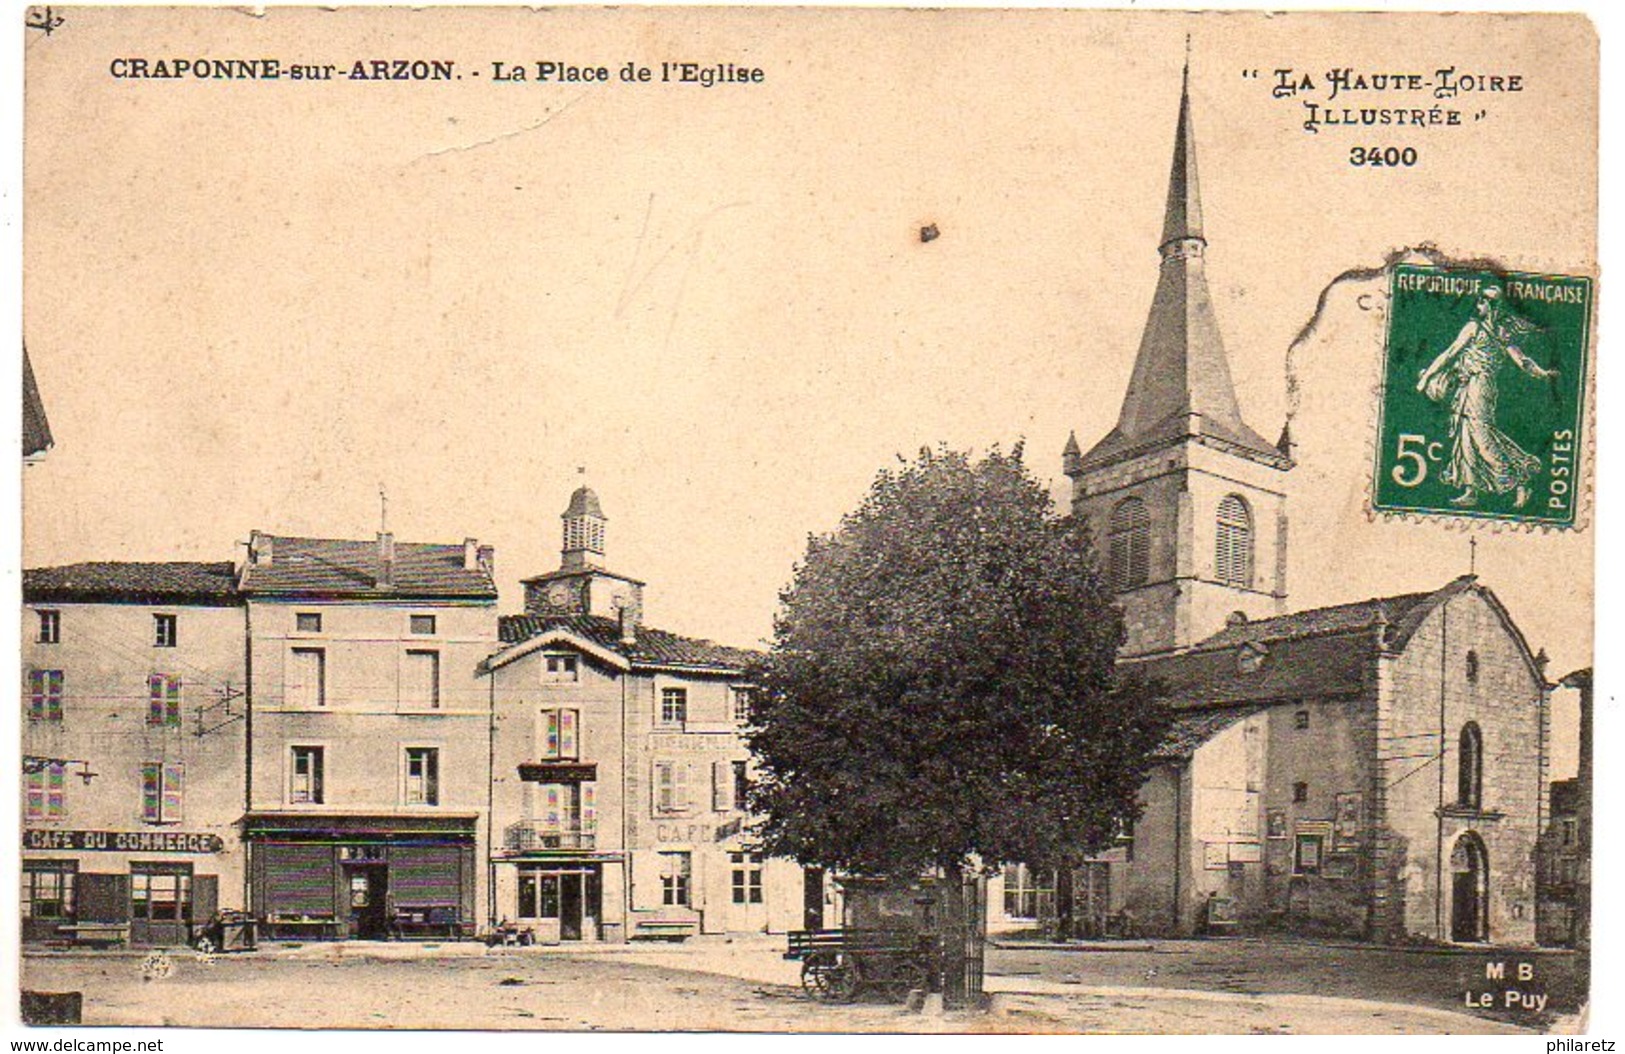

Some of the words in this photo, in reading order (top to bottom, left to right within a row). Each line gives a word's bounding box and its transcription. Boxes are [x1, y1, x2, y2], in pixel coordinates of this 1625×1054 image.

[1505, 280, 1583, 305] FRANÇAISE
[1548, 428, 1573, 510] POSTES
[30, 830, 74, 849] CAFE
[84, 831, 108, 849] DU
[115, 832, 211, 852] COMMERCE
